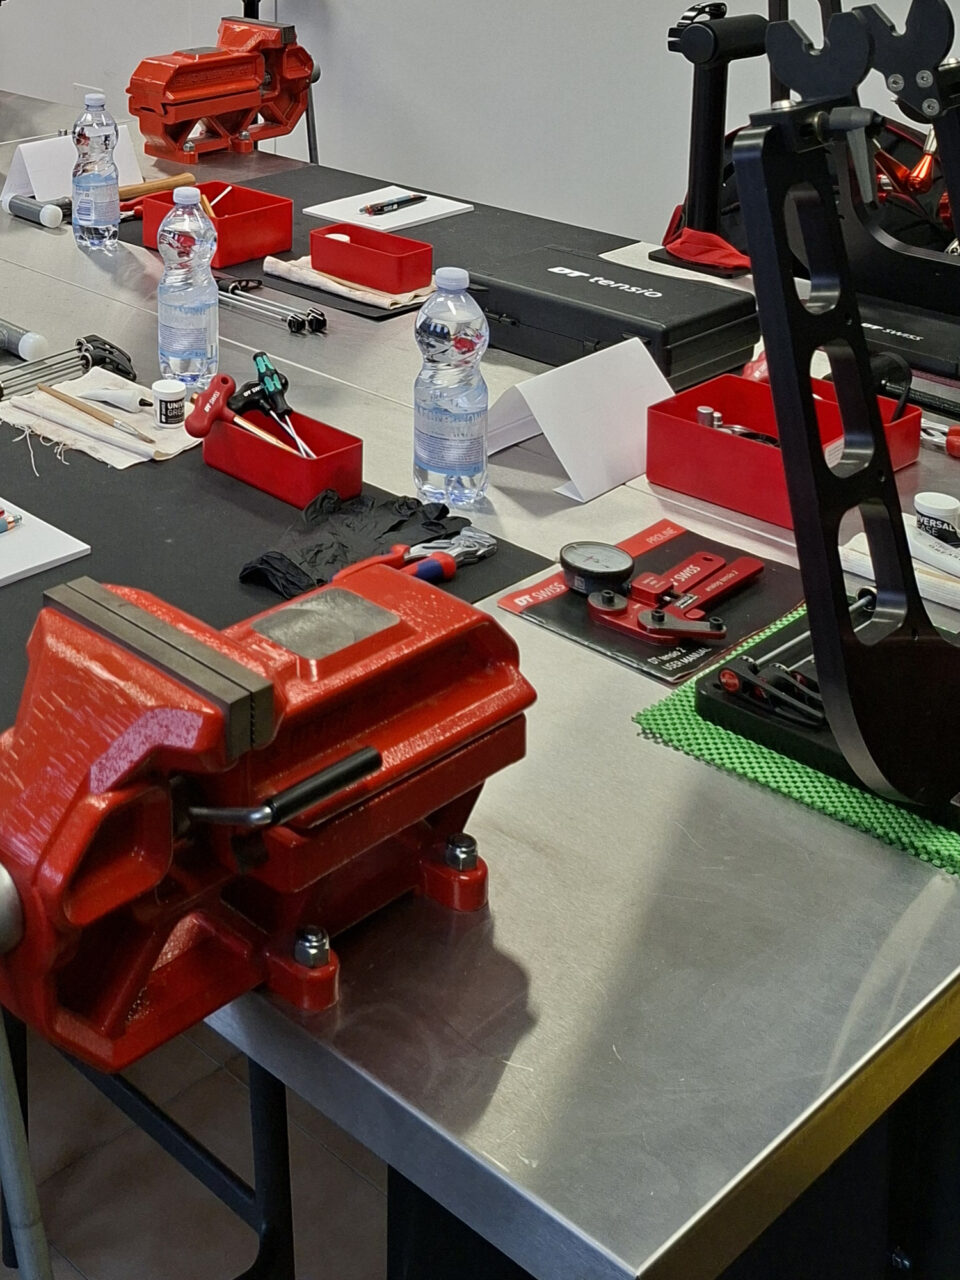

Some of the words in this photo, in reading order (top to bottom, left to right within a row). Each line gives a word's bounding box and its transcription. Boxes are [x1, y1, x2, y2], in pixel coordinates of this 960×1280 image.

[547, 266, 591, 278] DT
[589, 276, 663, 298] tensio
[645, 526, 680, 546] PROLINE
[674, 564, 701, 582] SWISS
[513, 594, 535, 607] DT
[533, 582, 567, 601] SWISS
[680, 647, 713, 664] MANUAL
